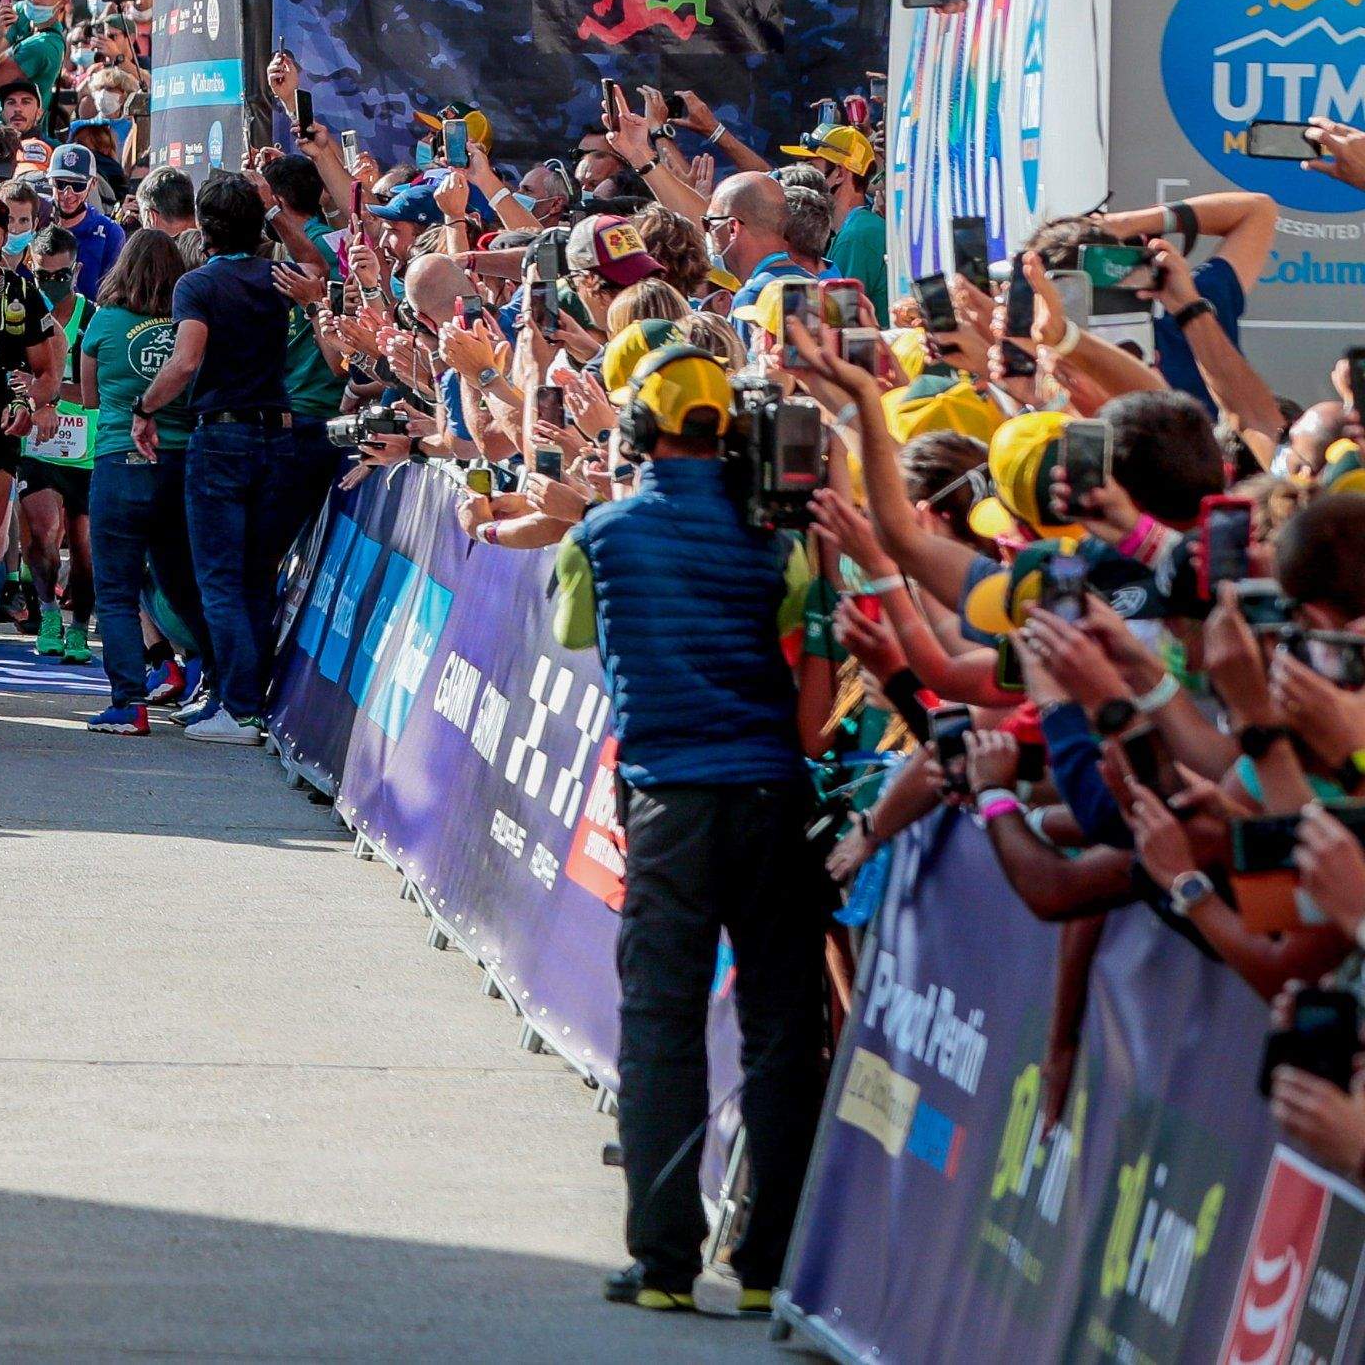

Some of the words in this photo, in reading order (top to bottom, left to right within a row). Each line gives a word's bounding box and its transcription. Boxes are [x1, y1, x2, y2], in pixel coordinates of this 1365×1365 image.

[1212, 61, 1365, 122] UTM
[57, 416, 84, 429] TMB
[58, 430, 72, 440] 99
